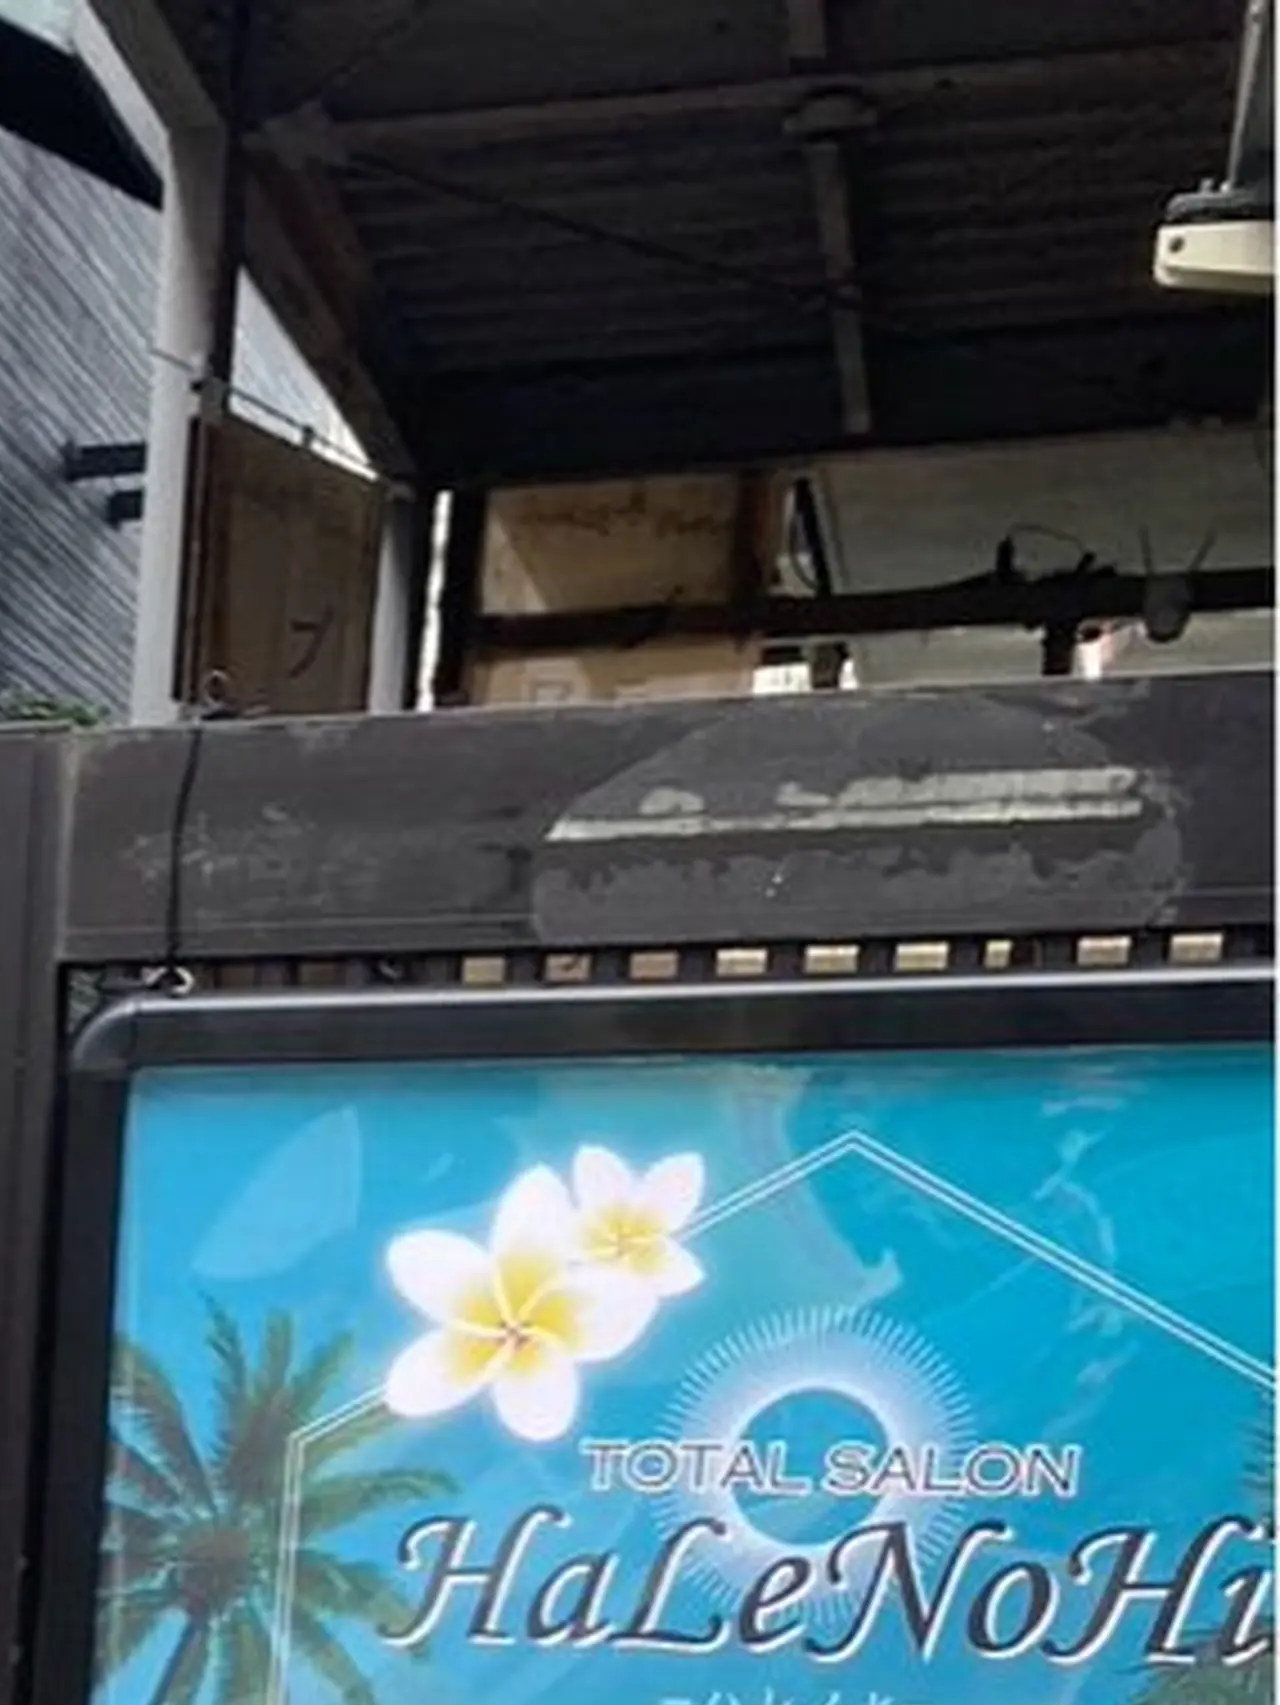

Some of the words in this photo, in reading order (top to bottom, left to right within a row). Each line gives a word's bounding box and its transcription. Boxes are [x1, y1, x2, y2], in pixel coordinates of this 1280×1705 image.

[580, 1437, 811, 1497] TOTAL
[822, 1441, 1081, 1499] SALON
[378, 1503, 1274, 1668] HaLeNoHi
